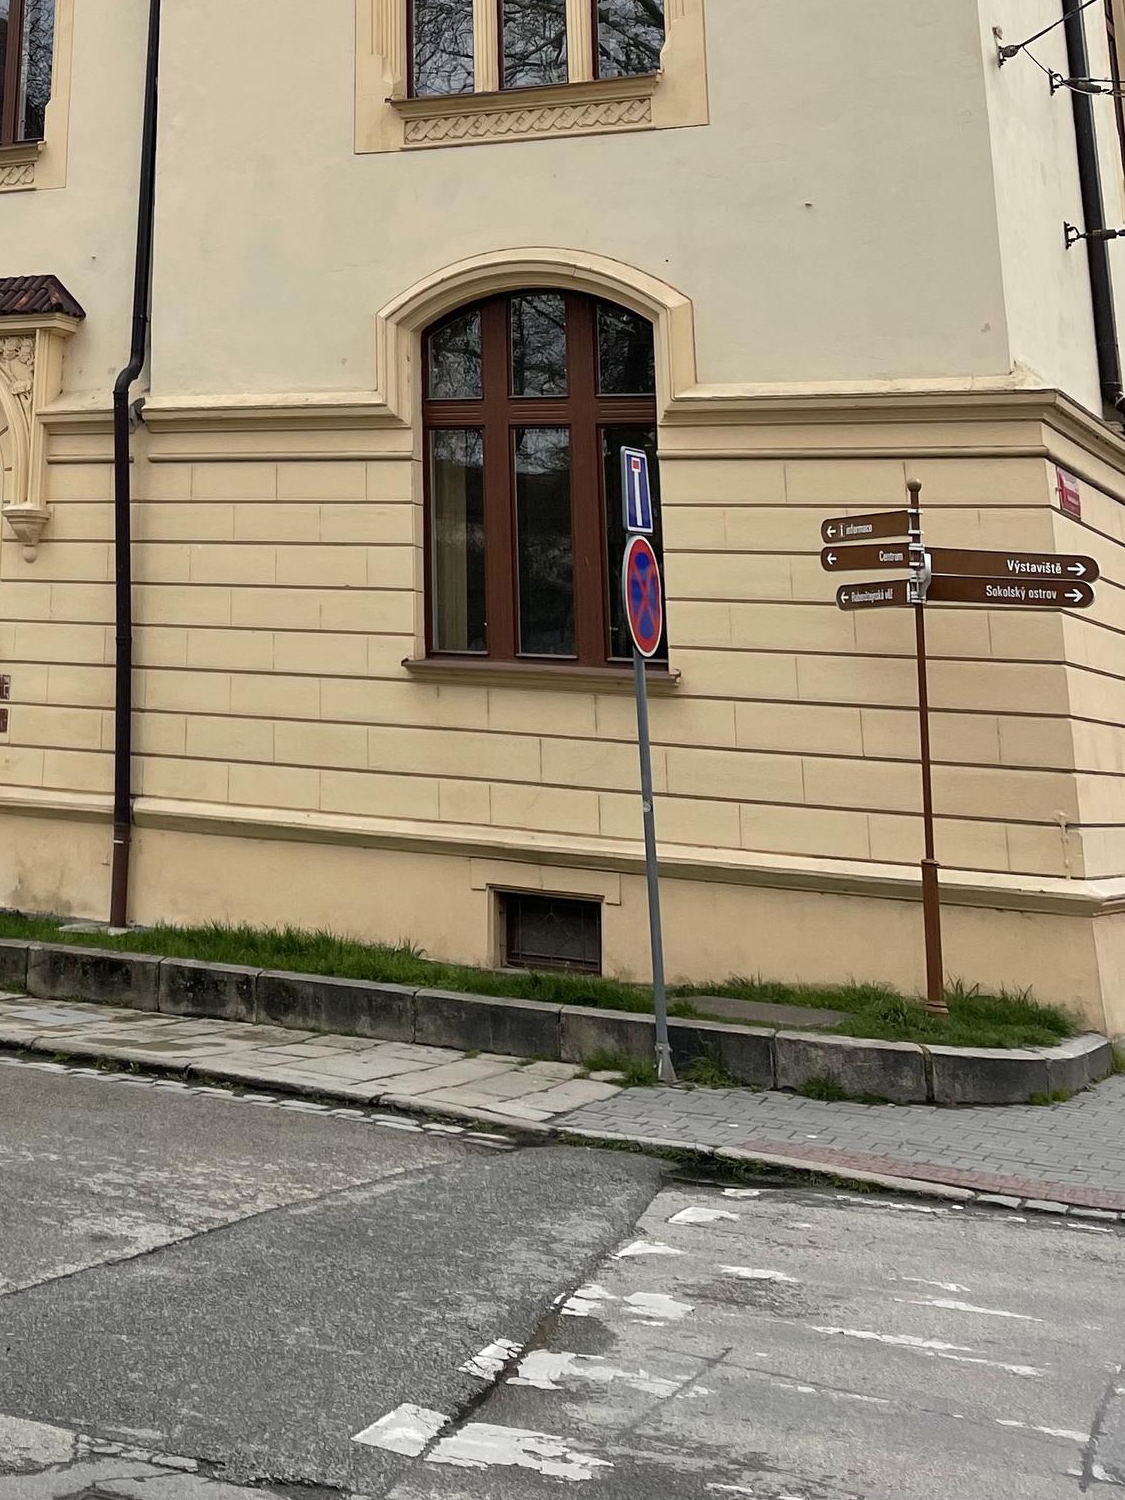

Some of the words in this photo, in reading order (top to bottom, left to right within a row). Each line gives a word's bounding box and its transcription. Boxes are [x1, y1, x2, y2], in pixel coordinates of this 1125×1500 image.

[879, 550, 904, 562] Centrum
[1007, 559, 1062, 574] Výstaviště
[986, 585, 1026, 600] Sokolský
[1028, 588, 1057, 599] ostrov
